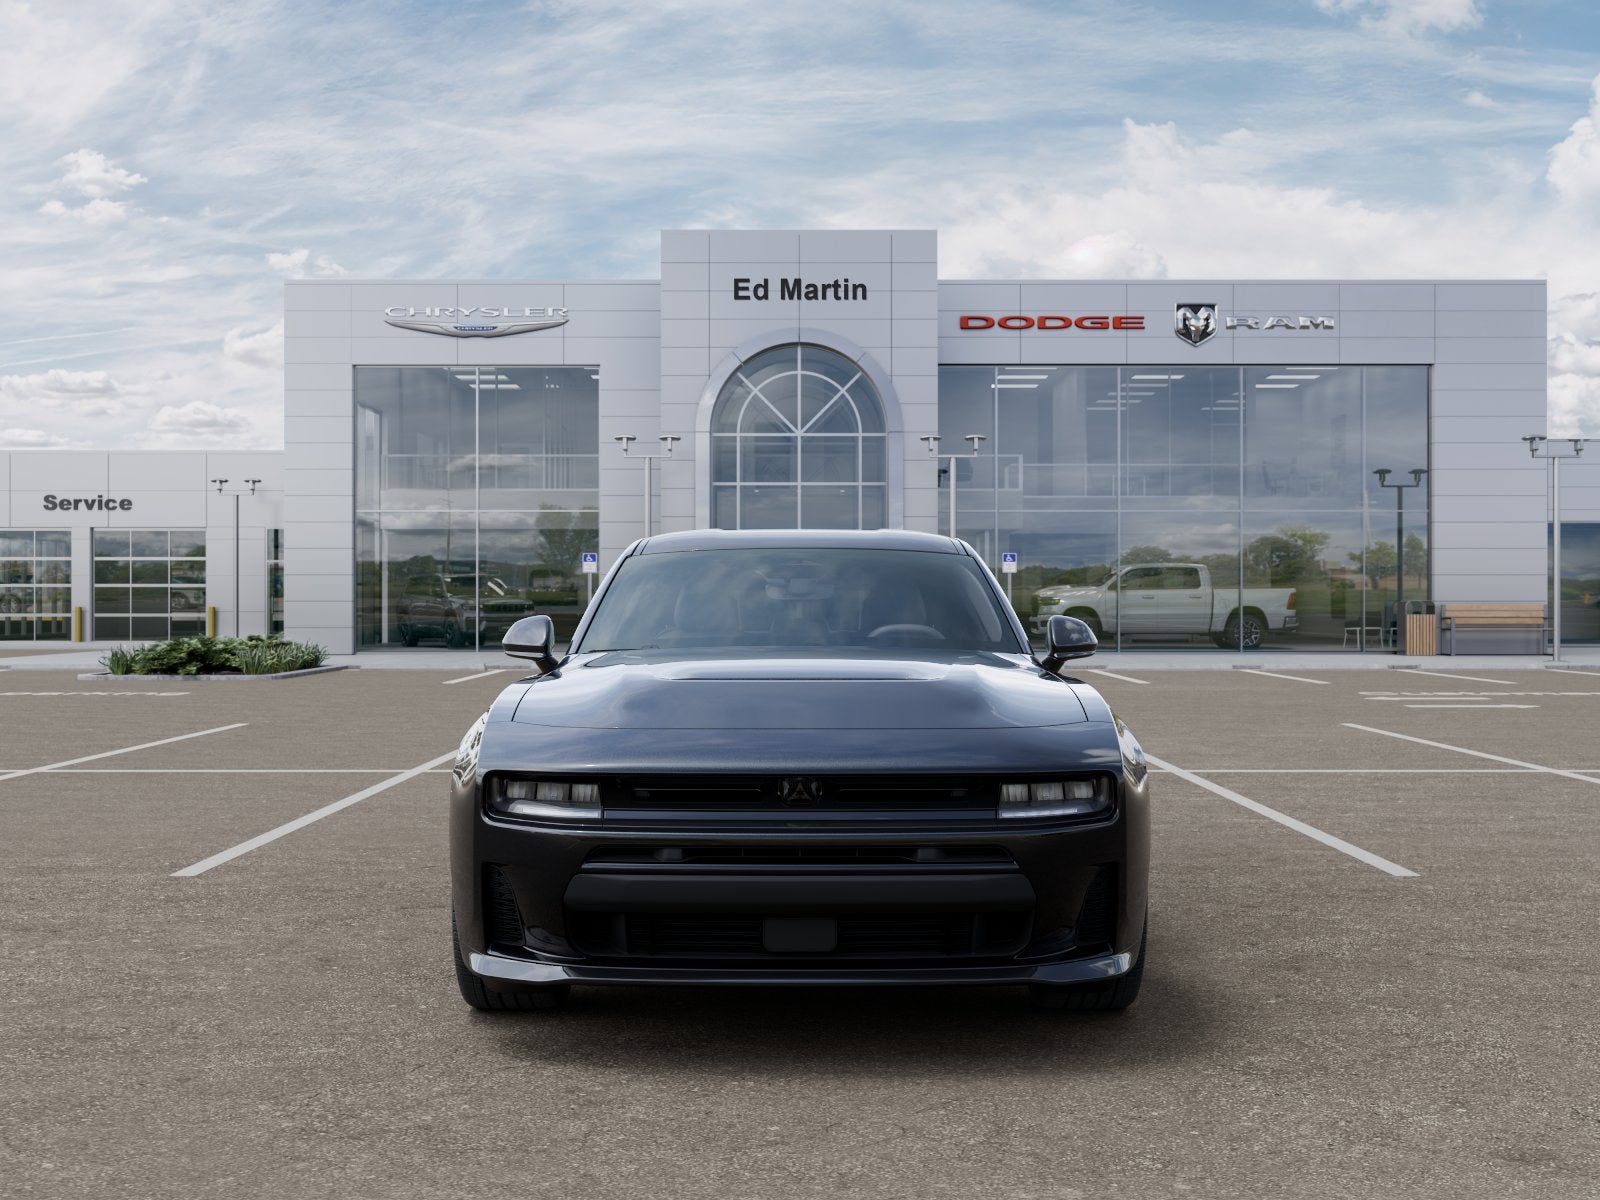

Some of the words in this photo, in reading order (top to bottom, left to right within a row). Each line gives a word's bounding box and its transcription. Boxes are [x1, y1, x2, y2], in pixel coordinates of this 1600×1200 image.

[734, 278, 769, 301] Ed
[780, 278, 868, 301] Martin
[385, 306, 569, 317] CHRYSLER
[959, 315, 1146, 330] DODGE
[1225, 315, 1335, 330] RAM
[43, 494, 133, 511] Service
